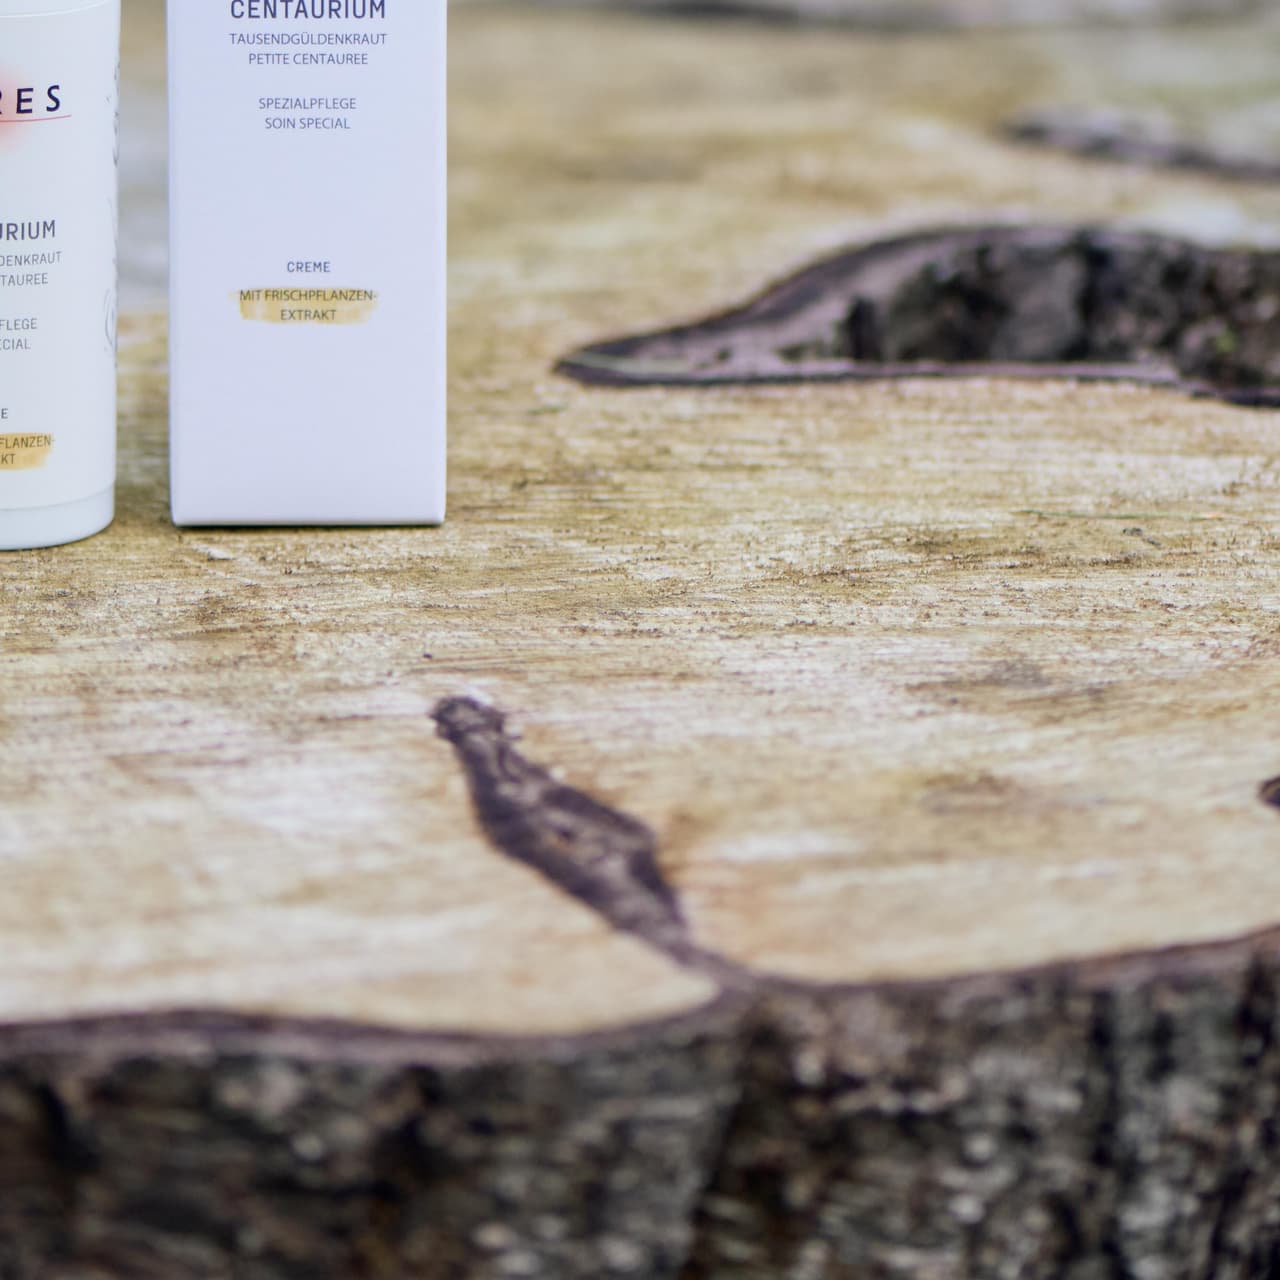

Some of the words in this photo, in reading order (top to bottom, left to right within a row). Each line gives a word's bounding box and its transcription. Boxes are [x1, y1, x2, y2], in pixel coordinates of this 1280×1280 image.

[229, 32, 387, 45] TAUSENDGÜLDENKRAUT
[248, 53, 290, 65] PETITE
[292, 53, 368, 65] CENTAUREE
[258, 97, 357, 110] SPEZIALPFLEGE
[265, 117, 296, 129] SOIN
[298, 117, 351, 129] SPECIAL
[287, 261, 331, 273] CREME
[239, 289, 262, 302] MIT
[264, 289, 377, 302] FRISCHPFLANZEN-
[280, 309, 337, 321] EXTRAKT
